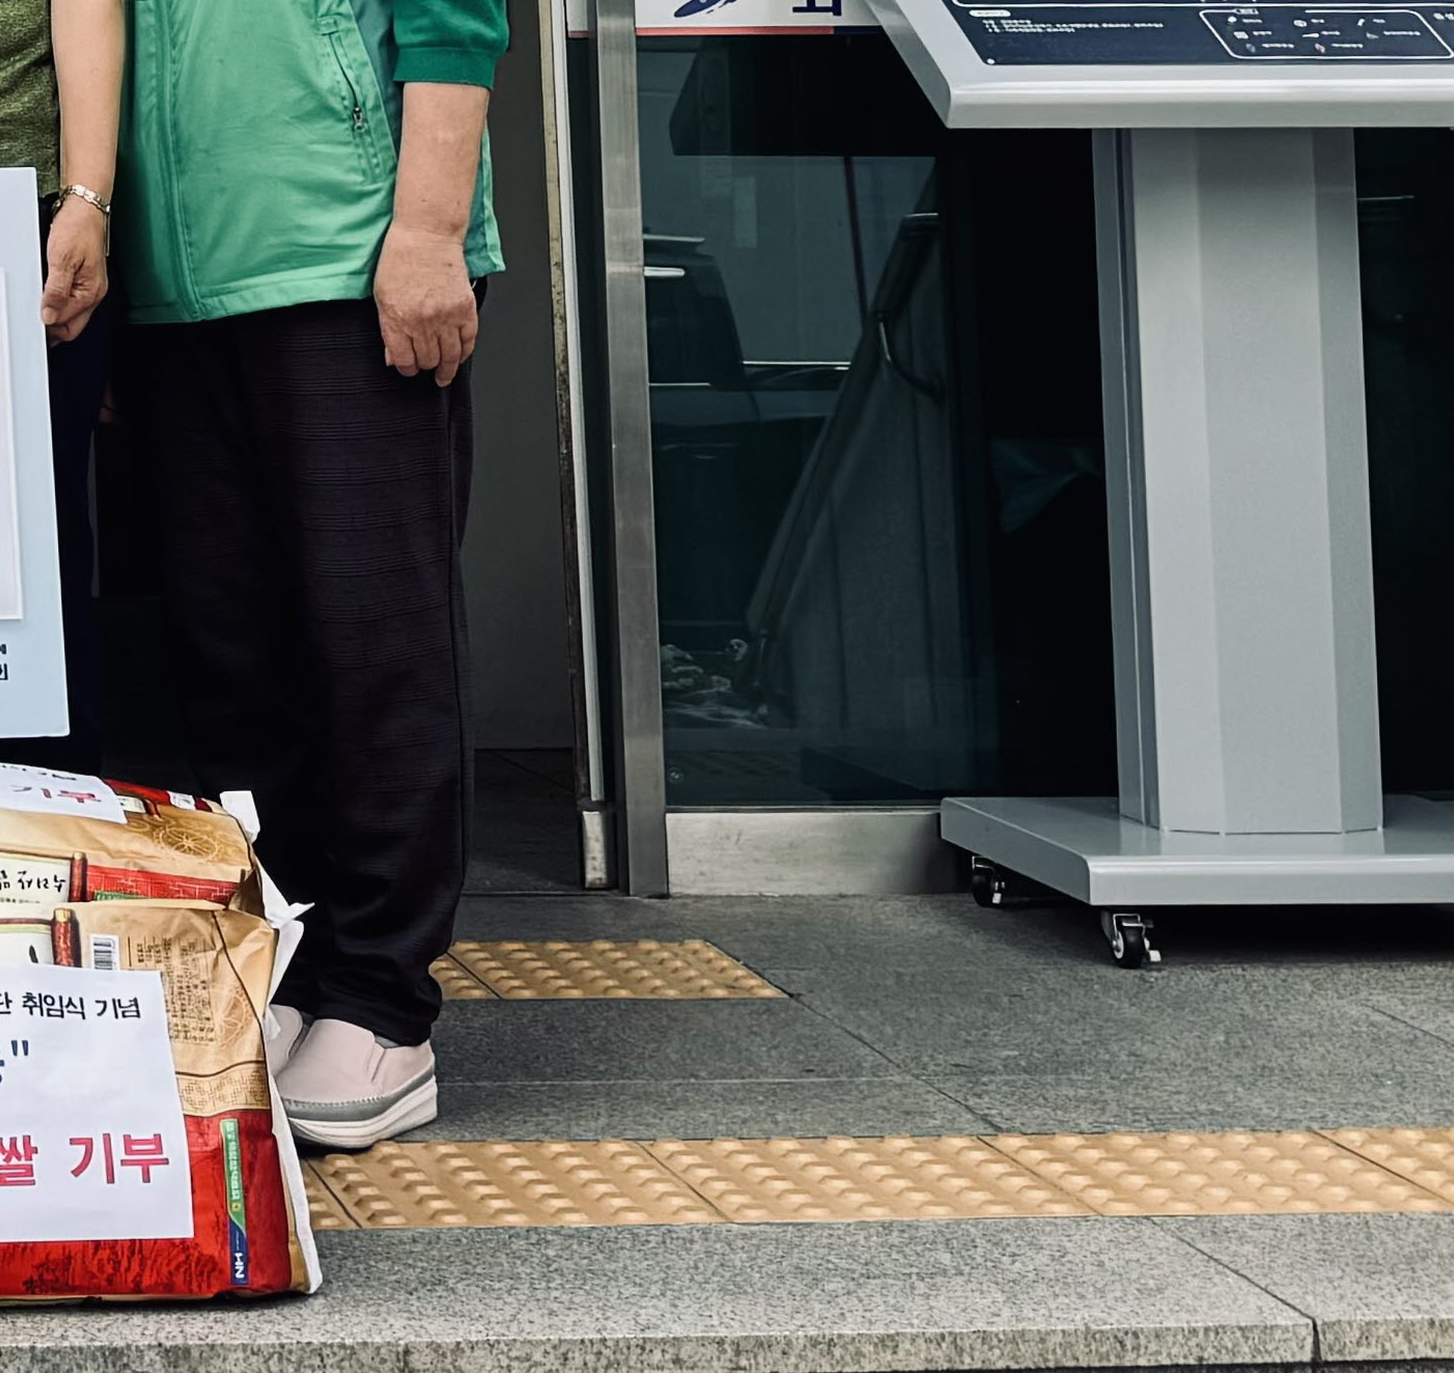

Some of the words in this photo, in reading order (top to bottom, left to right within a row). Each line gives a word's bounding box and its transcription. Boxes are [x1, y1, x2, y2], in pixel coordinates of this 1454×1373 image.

[22, 991, 86, 1021] 취임식
[94, 996, 141, 1020] 기념
[68, 1132, 170, 1185] 기부
